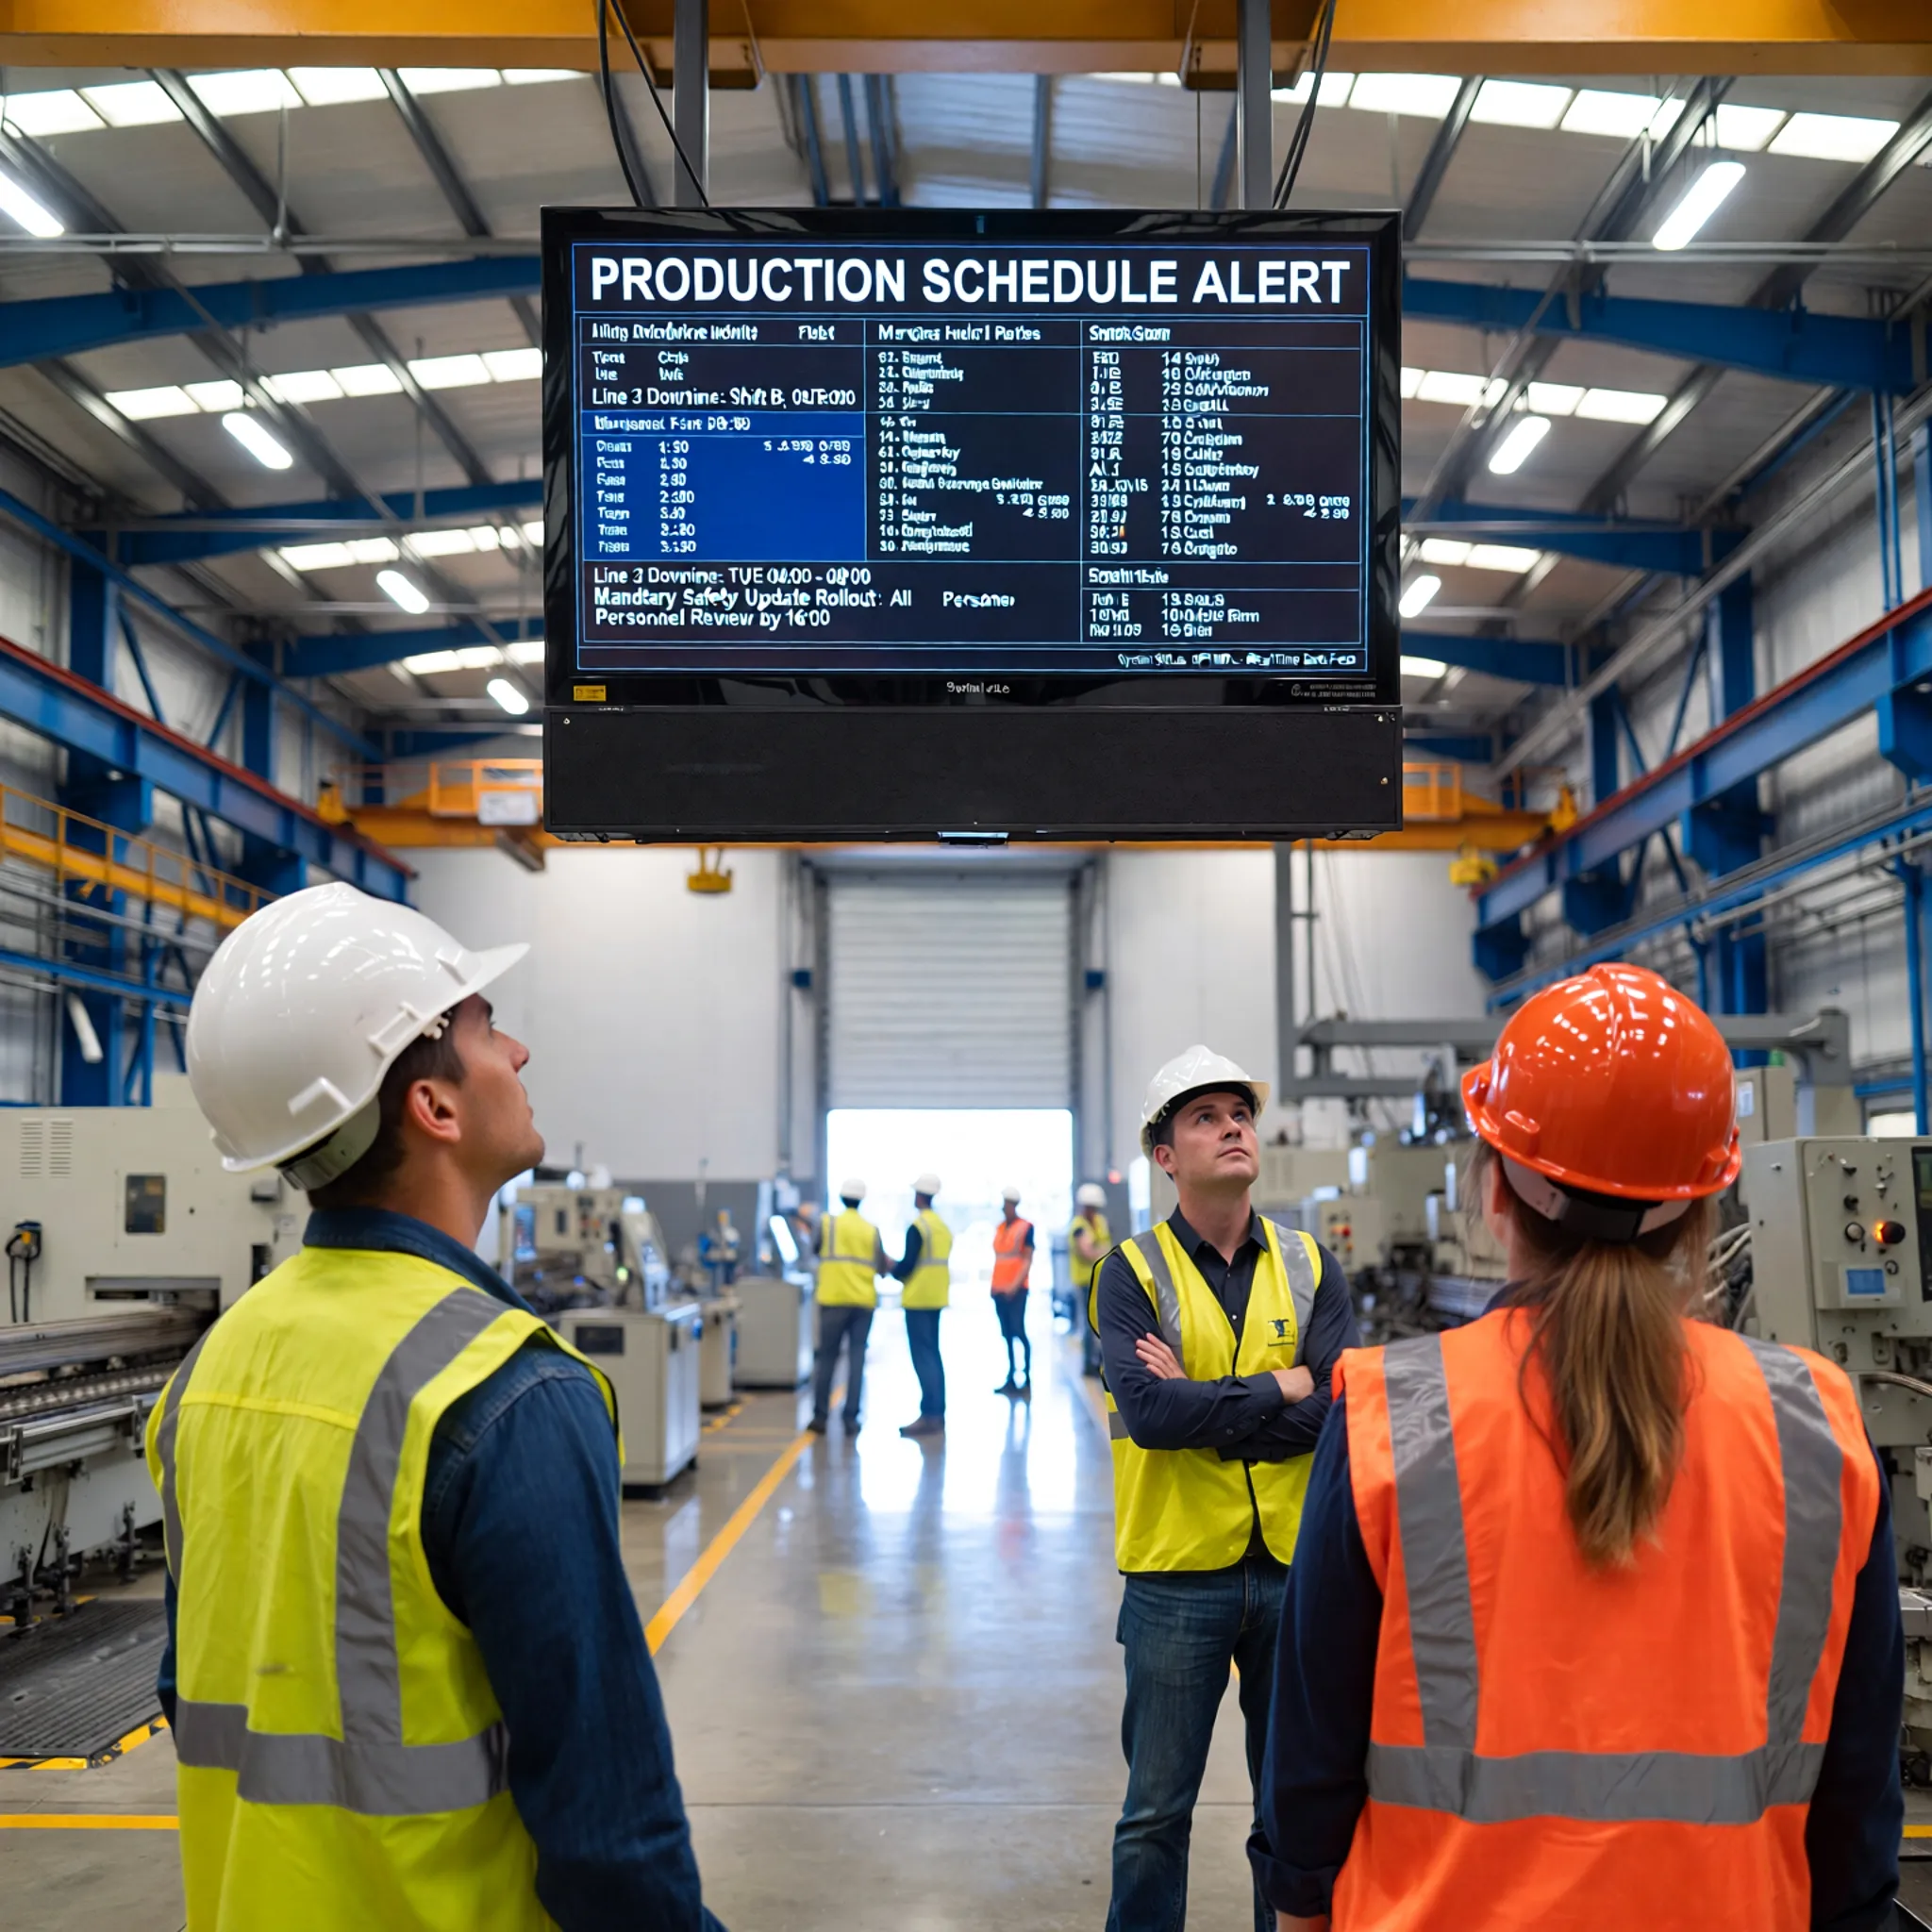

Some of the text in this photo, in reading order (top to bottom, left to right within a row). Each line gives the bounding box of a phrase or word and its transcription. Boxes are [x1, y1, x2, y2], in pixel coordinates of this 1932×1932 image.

[591, 257, 1351, 304] PRODUCTION SCHEDULE ALERT
[592, 387, 628, 406] Line
[593, 566, 628, 584] Line
[727, 566, 764, 586] TUE
[890, 589, 912, 608] All
[595, 606, 685, 626] Personnel
